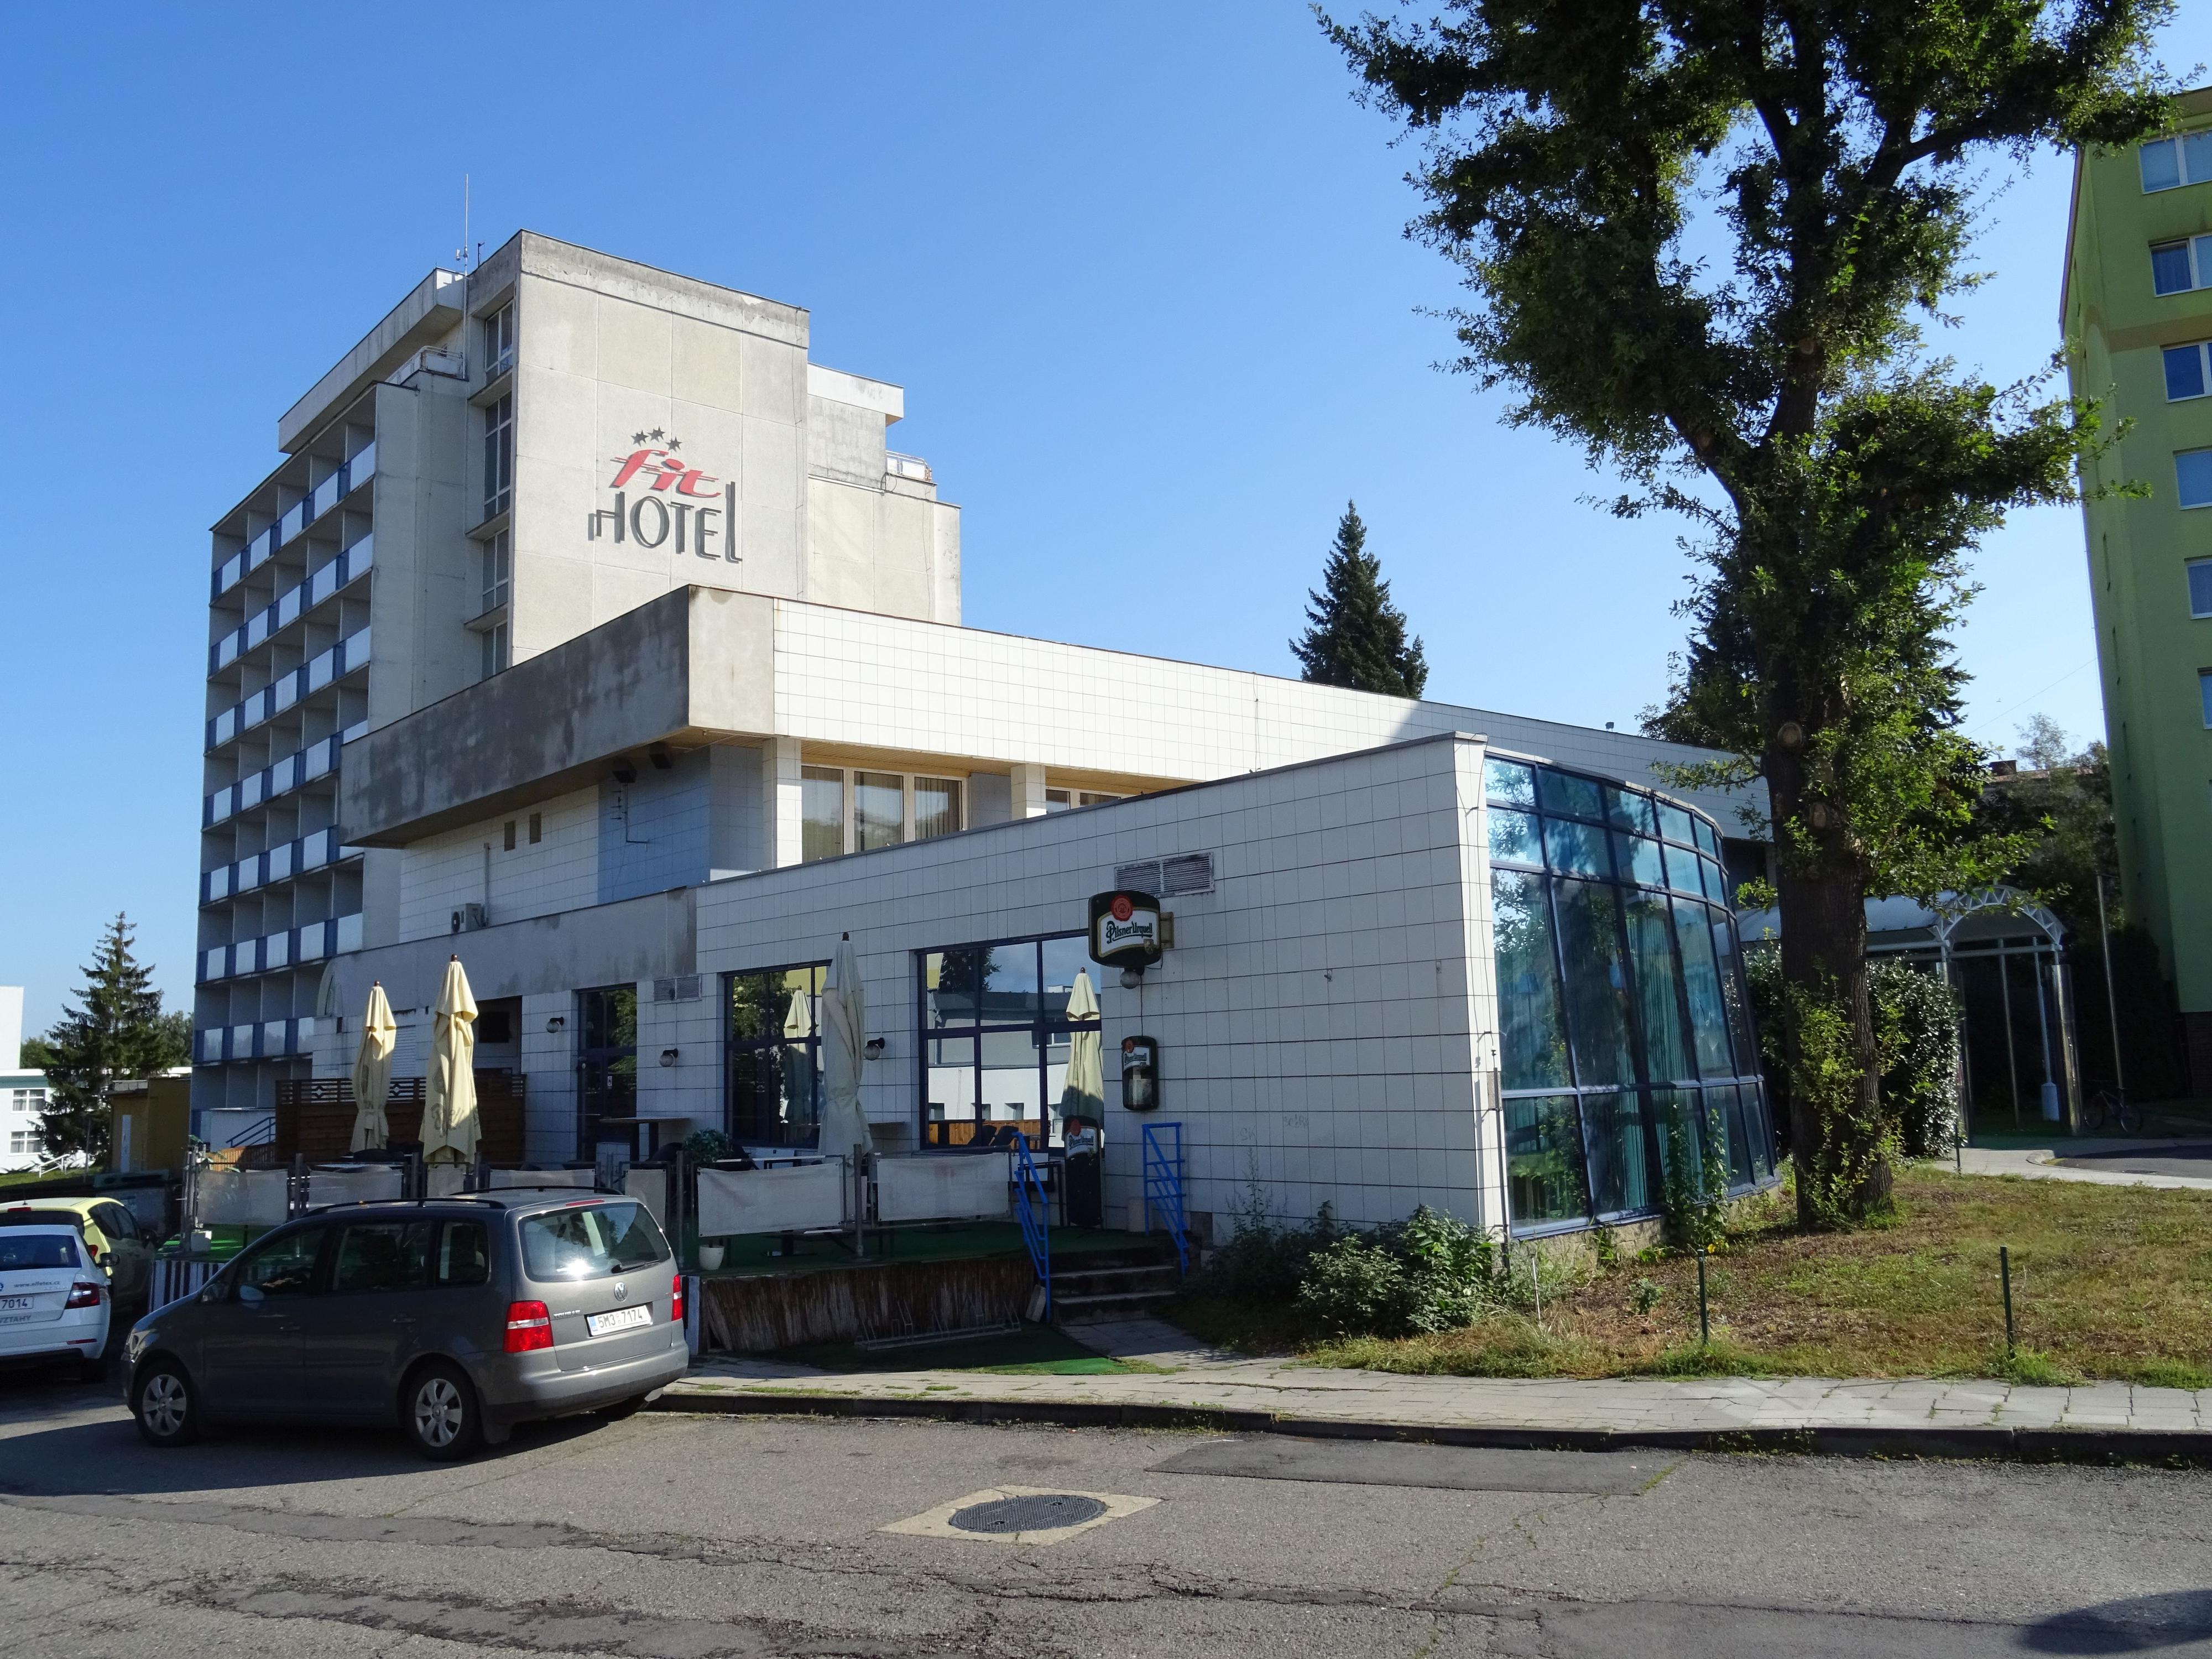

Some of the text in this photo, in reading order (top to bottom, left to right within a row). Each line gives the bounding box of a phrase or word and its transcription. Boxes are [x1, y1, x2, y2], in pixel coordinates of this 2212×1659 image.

[610, 449, 721, 498] fit
[588, 481, 743, 563] HOTEL
[1106, 921, 1153, 944] Pilsner Urquell
[2, 1298, 28, 1309] 7014
[597, 1310, 643, 1328] 5M3 7174
